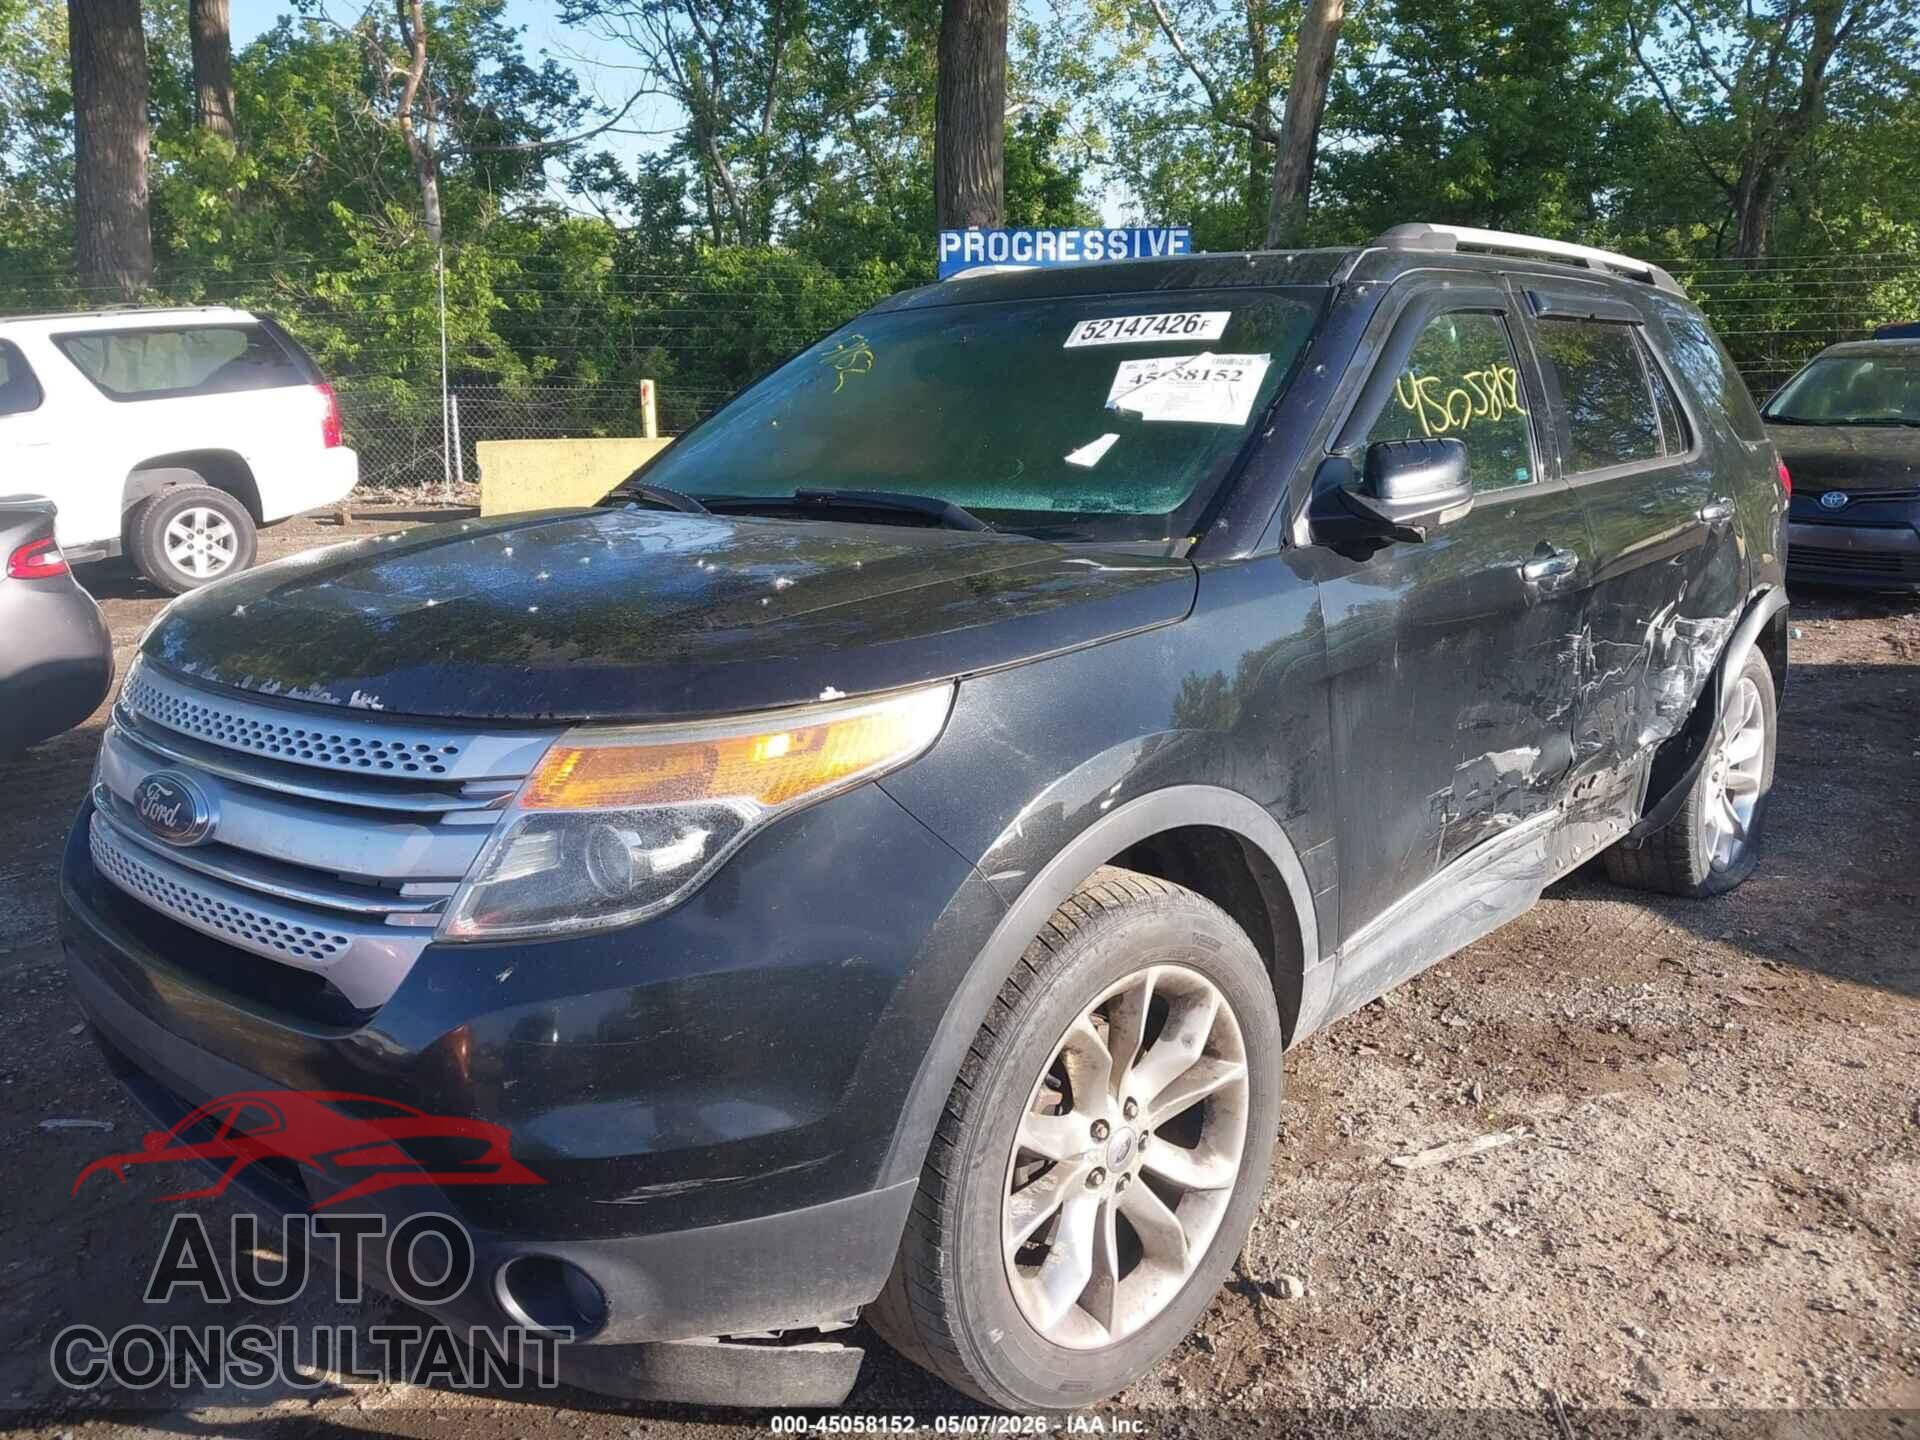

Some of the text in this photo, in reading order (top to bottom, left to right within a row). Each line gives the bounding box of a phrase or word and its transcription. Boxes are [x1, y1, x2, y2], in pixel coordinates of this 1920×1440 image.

[940, 230, 1190, 263] PROGRESSIVE
[1129, 366, 1244, 386] 4558152
[141, 782, 182, 828] Ford
